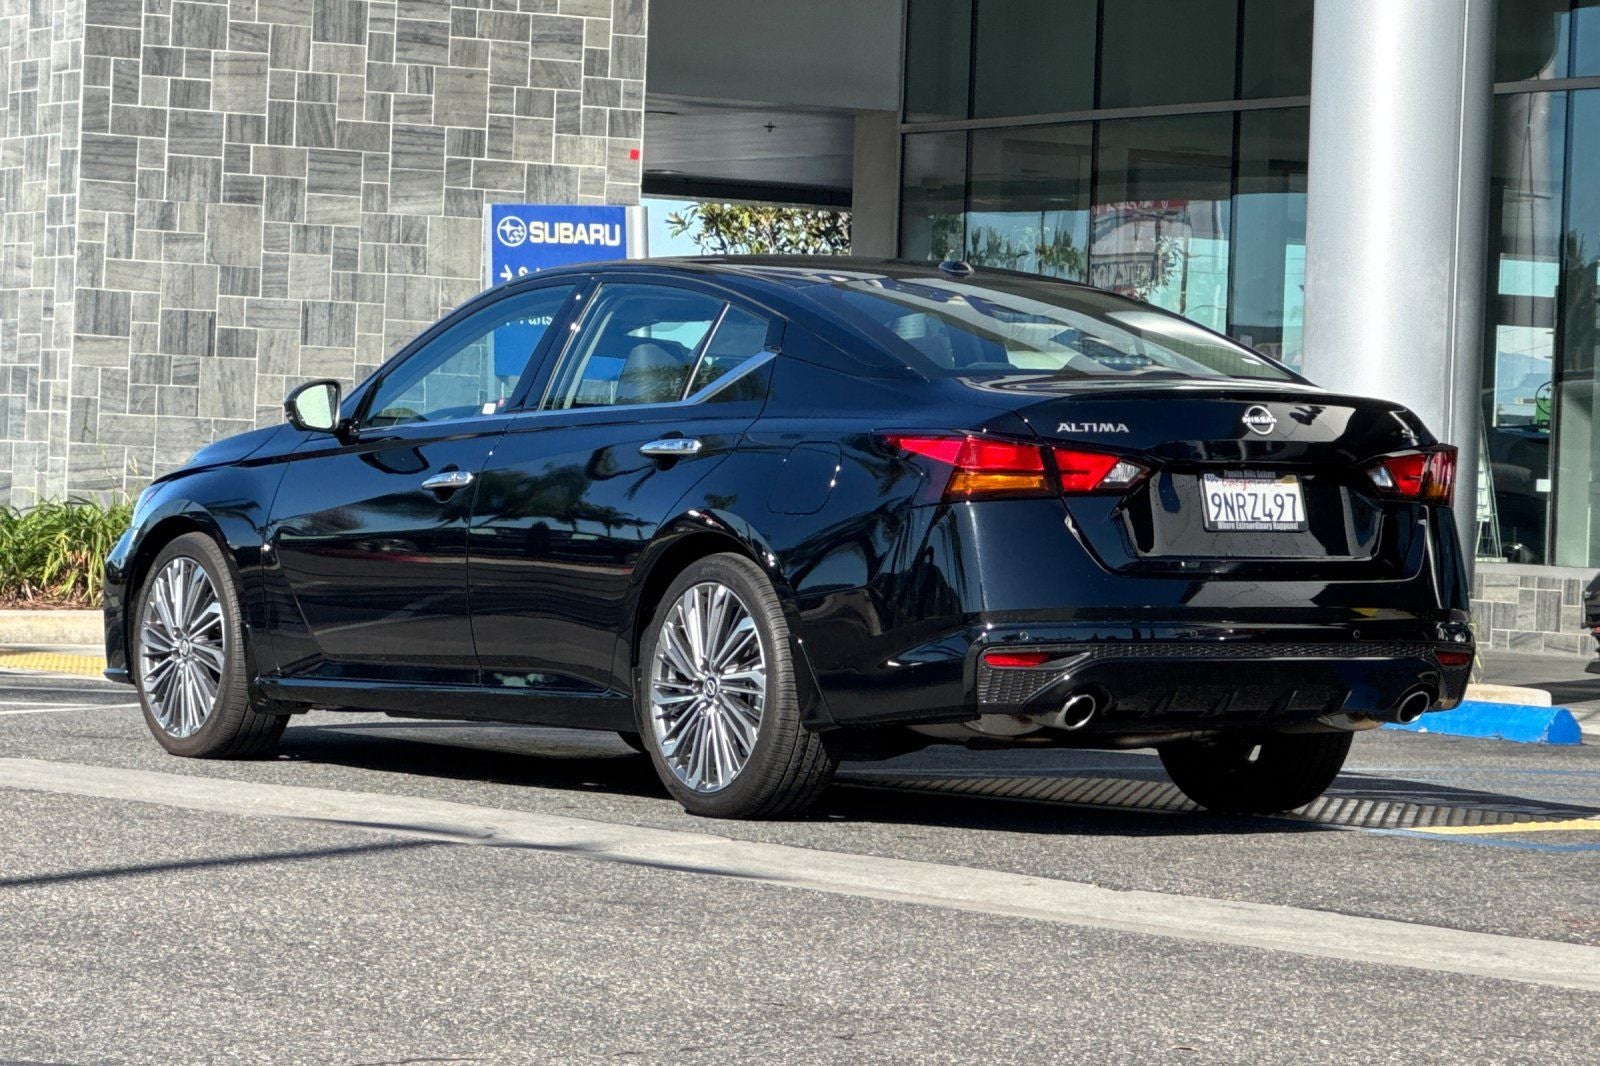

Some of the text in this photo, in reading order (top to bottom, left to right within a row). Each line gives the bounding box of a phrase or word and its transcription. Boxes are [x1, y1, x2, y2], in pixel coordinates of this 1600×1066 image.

[529, 221, 621, 246] SUBARU
[1057, 422, 1130, 434] ALTIMA
[1241, 416, 1278, 424] NISSAN
[1210, 492, 1297, 521] 9NRZ497
